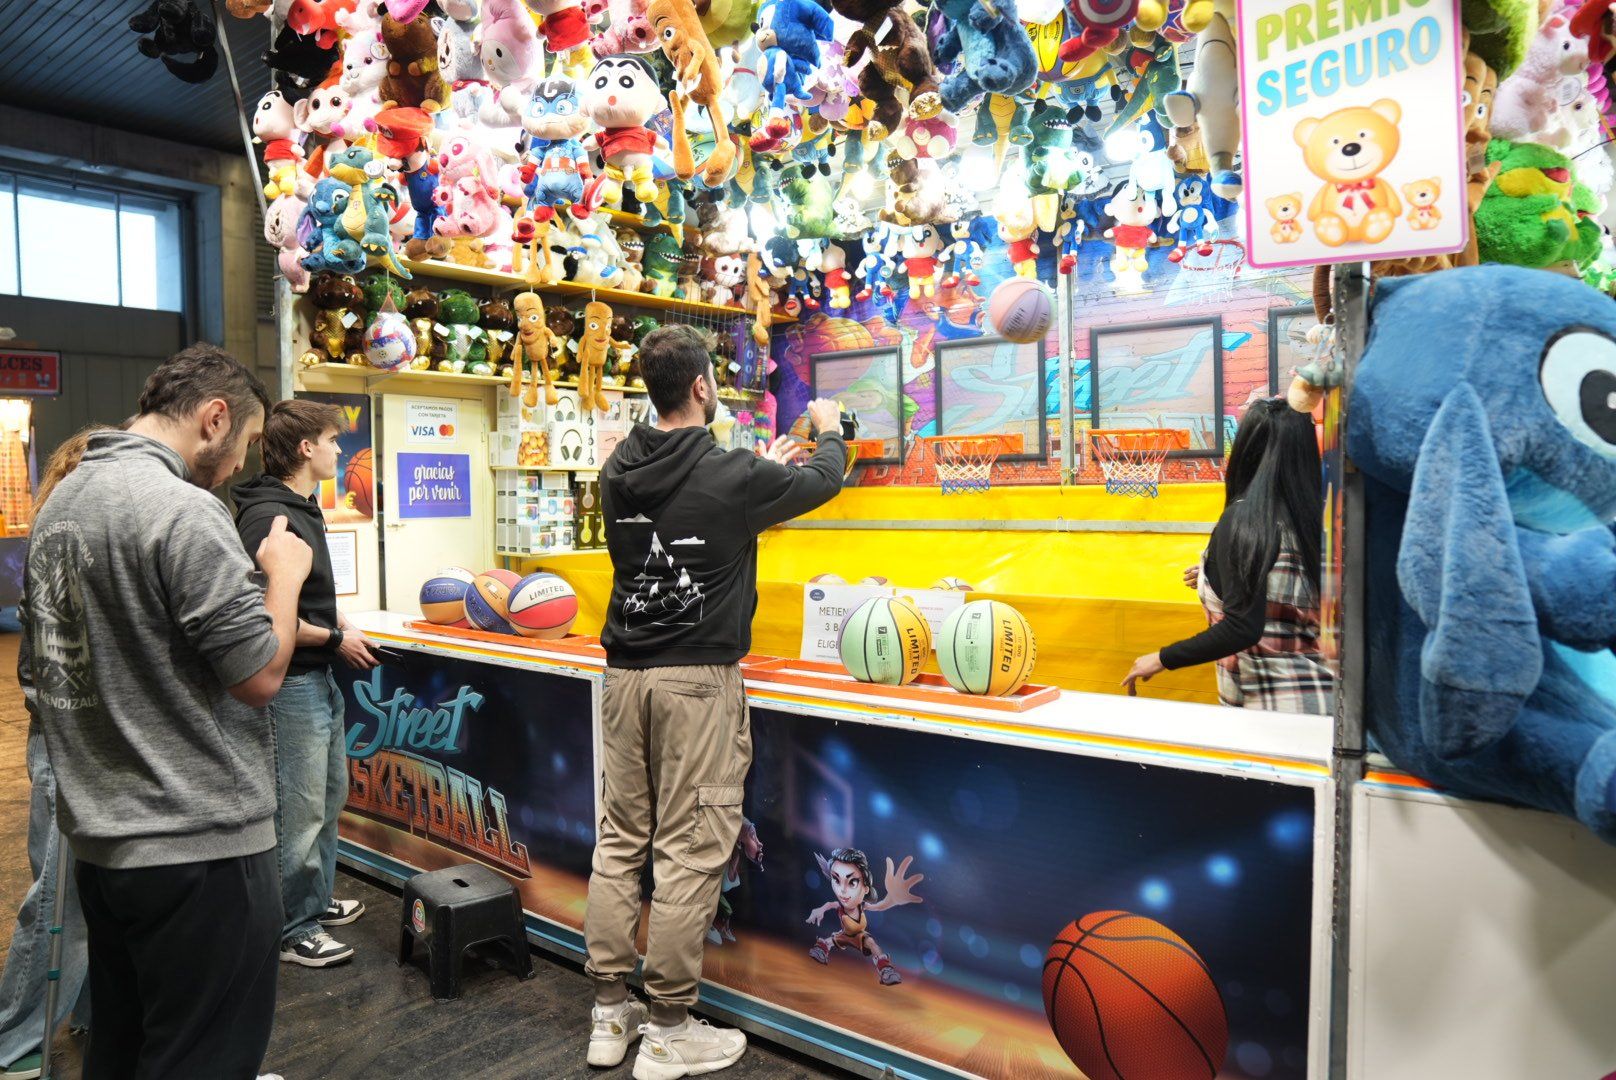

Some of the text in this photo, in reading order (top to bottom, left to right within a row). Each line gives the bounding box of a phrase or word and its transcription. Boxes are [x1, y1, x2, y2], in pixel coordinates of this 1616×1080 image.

[1256, 0, 1430, 61] PREM
[1256, 16, 1441, 116] SEGURO
[411, 425, 435, 436] VISA
[414, 461, 455, 485] gracias
[409, 481, 462, 506] por venir
[528, 585, 565, 600] LIMITED
[819, 606, 851, 616] METIEN
[825, 622, 831, 631] 3
[906, 628, 920, 675] LIMITED
[1002, 619, 1014, 673] LIMITED
[345, 665, 485, 760] Street
[345, 743, 533, 880] SKETBALL
